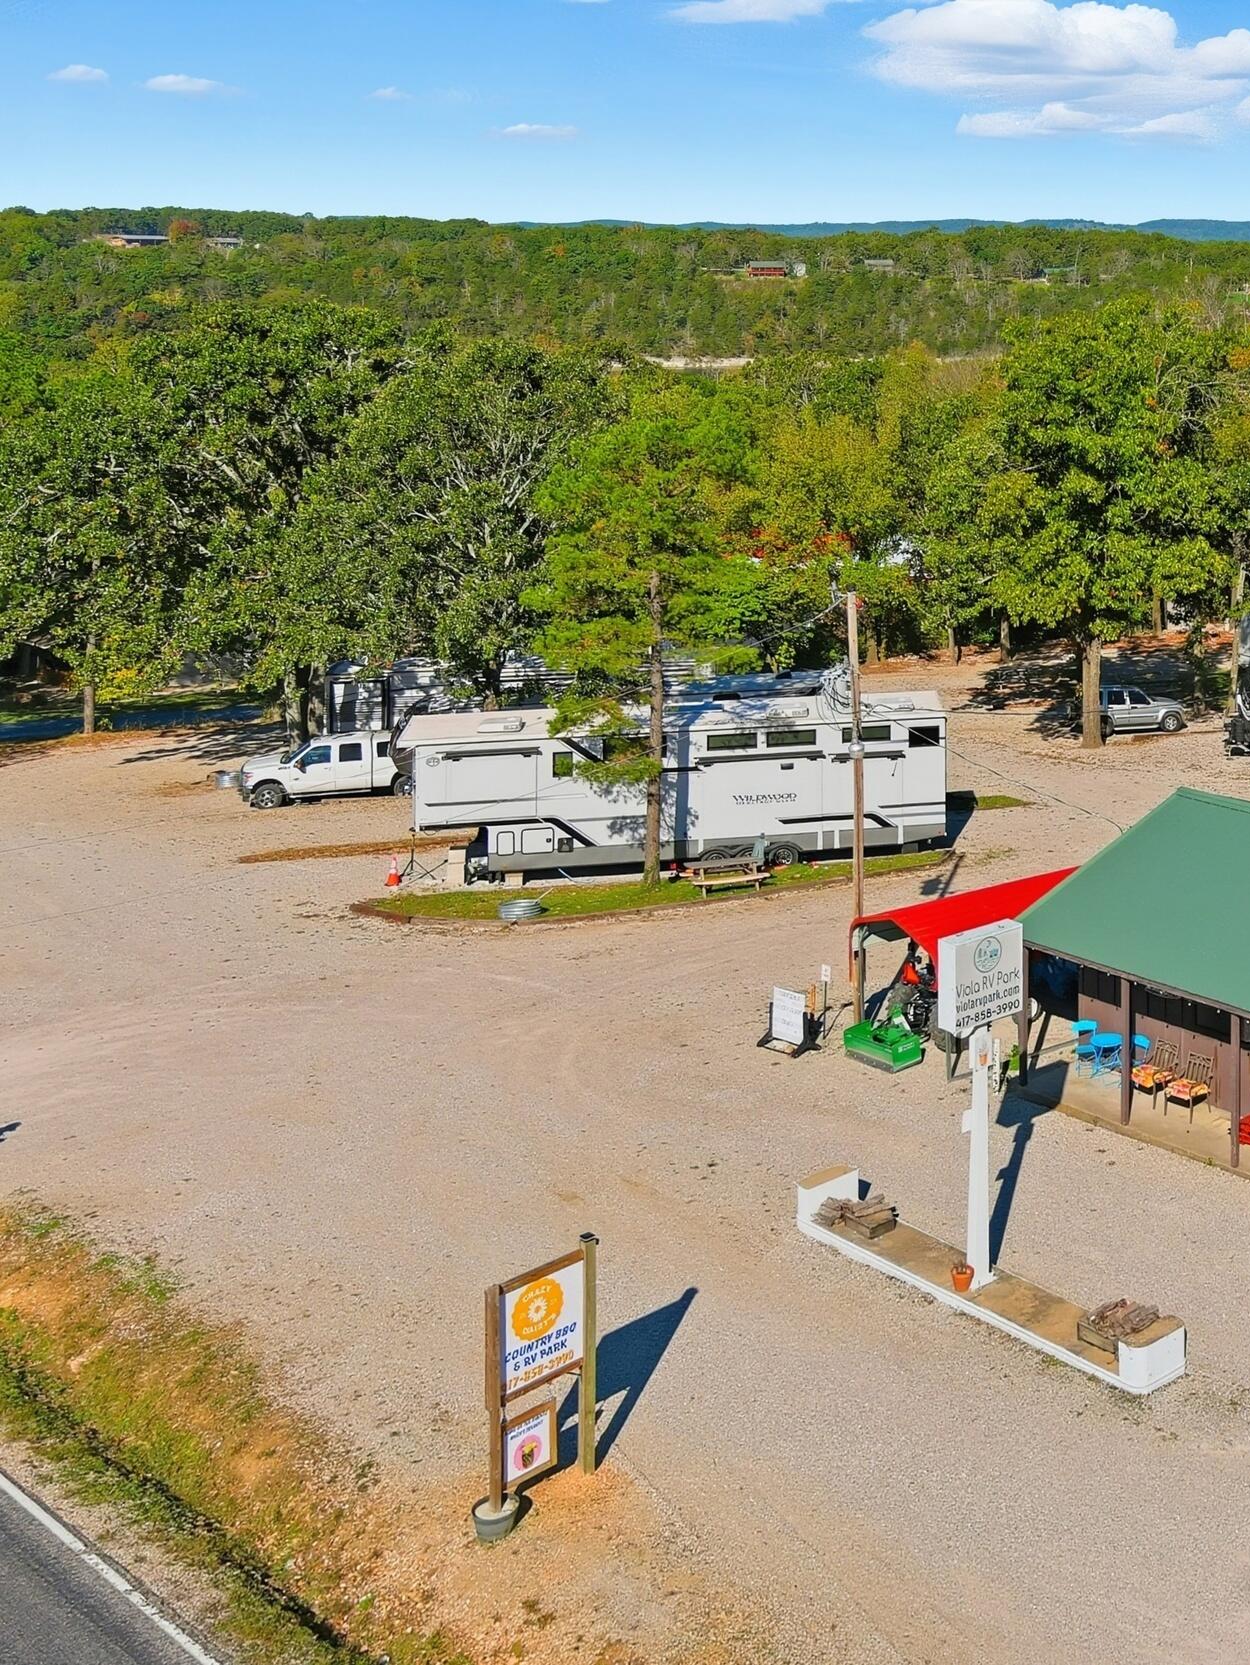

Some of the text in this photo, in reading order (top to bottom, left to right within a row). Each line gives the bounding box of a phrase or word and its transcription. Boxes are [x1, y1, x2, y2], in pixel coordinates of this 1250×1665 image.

[732, 792, 798, 802] WILDWOOD
[956, 967, 1020, 998] Viola RV Park
[956, 985, 1020, 1013] violarvpark.com
[956, 999, 1020, 1028] 417-858-3990
[505, 1333, 554, 1364] COUNTRY
[513, 1338, 568, 1372] & RV PARK
[508, 1349, 575, 1390] 17-858-3990
